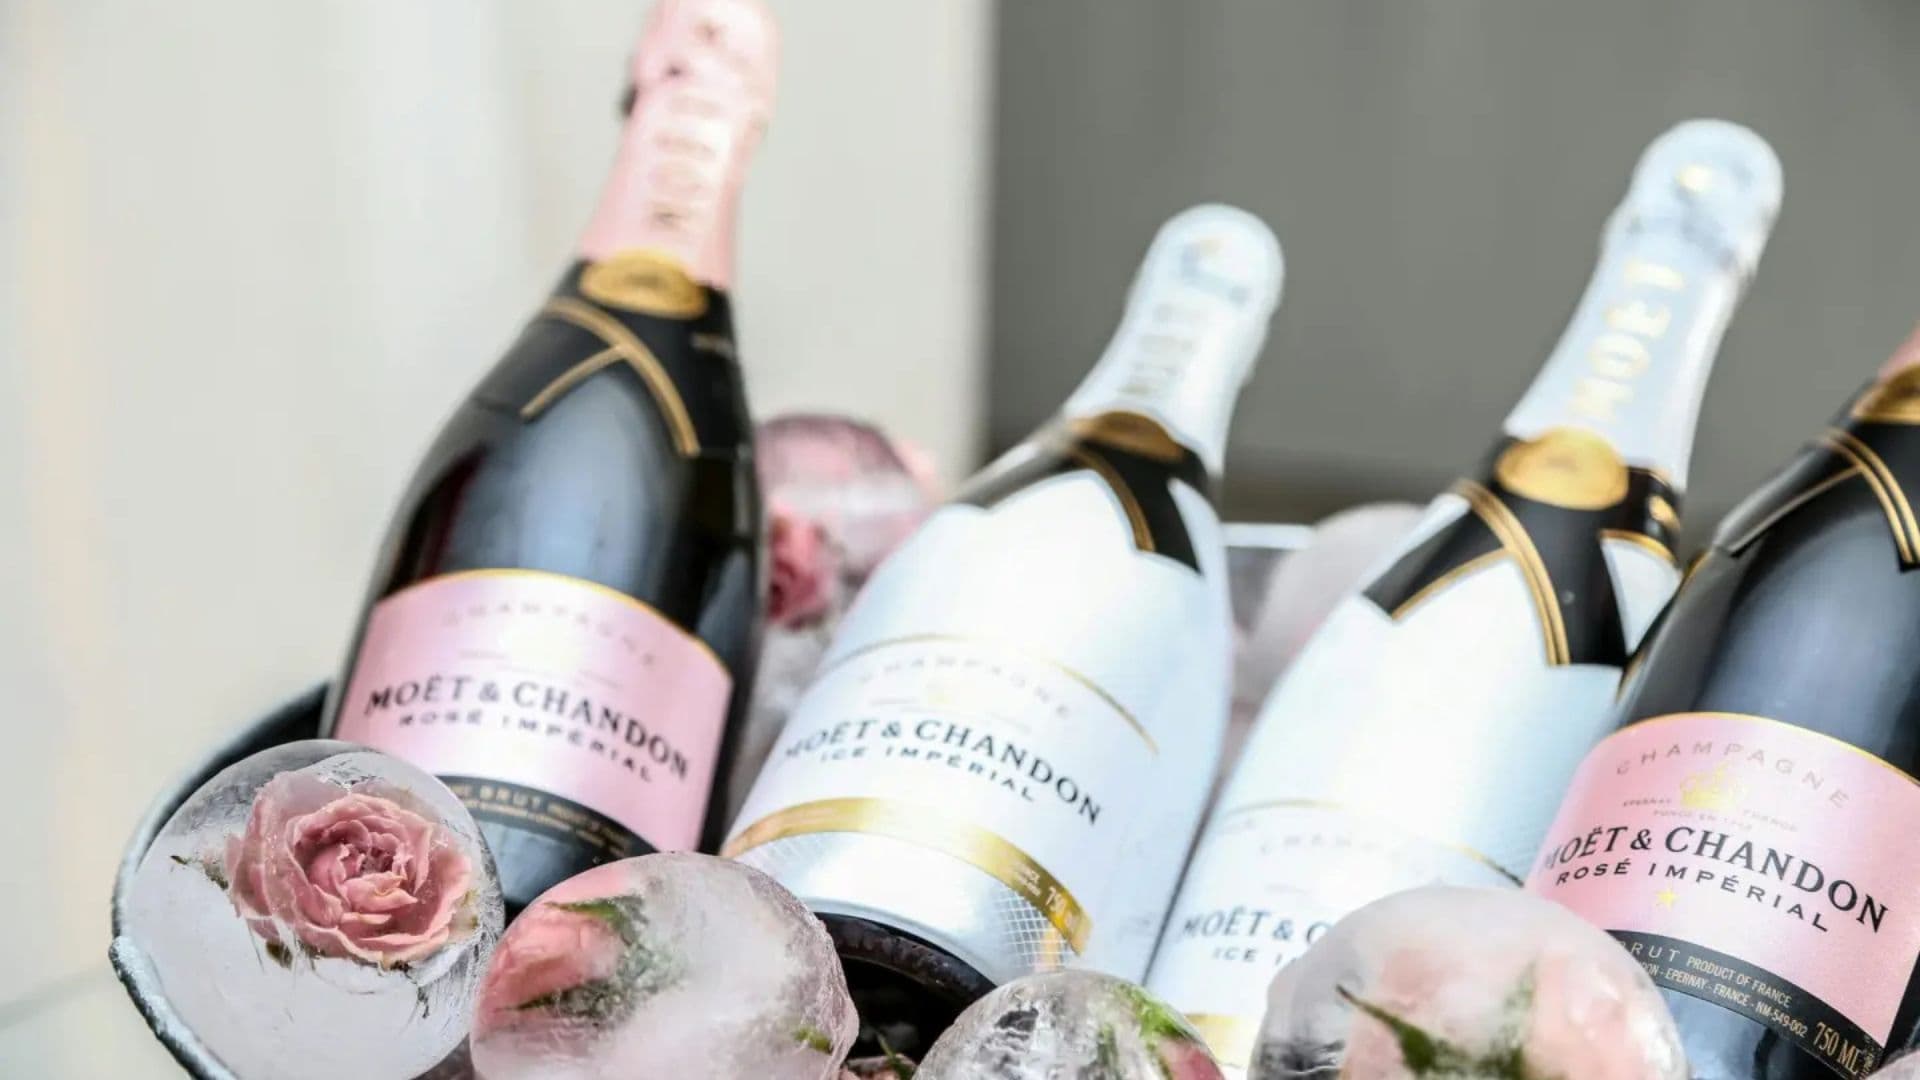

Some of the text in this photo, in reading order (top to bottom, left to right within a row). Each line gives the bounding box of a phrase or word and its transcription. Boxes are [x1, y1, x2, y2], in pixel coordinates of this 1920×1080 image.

[479, 681, 499, 702] &
[512, 680, 689, 780] CHANDON
[881, 720, 901, 739] &
[915, 719, 1102, 826] CHANDON
[1616, 742, 1851, 810] CHAMPAGNE
[1556, 857, 1830, 933] ROSÉ IMPÉRIAL
[1630, 828, 1652, 851] &
[1665, 825, 1889, 934] CHANDON
[1212, 946, 1259, 964] ICE
[1273, 919, 1293, 941] &
[1665, 967, 1710, 990] EPERNAY
[1712, 983, 1750, 1008] FRANCE
[1686, 955, 1736, 980] PRODUCT
[1736, 973, 1751, 987] OF
[1752, 979, 1793, 1009] FRANCE
[1813, 1021, 1840, 1057] 750
